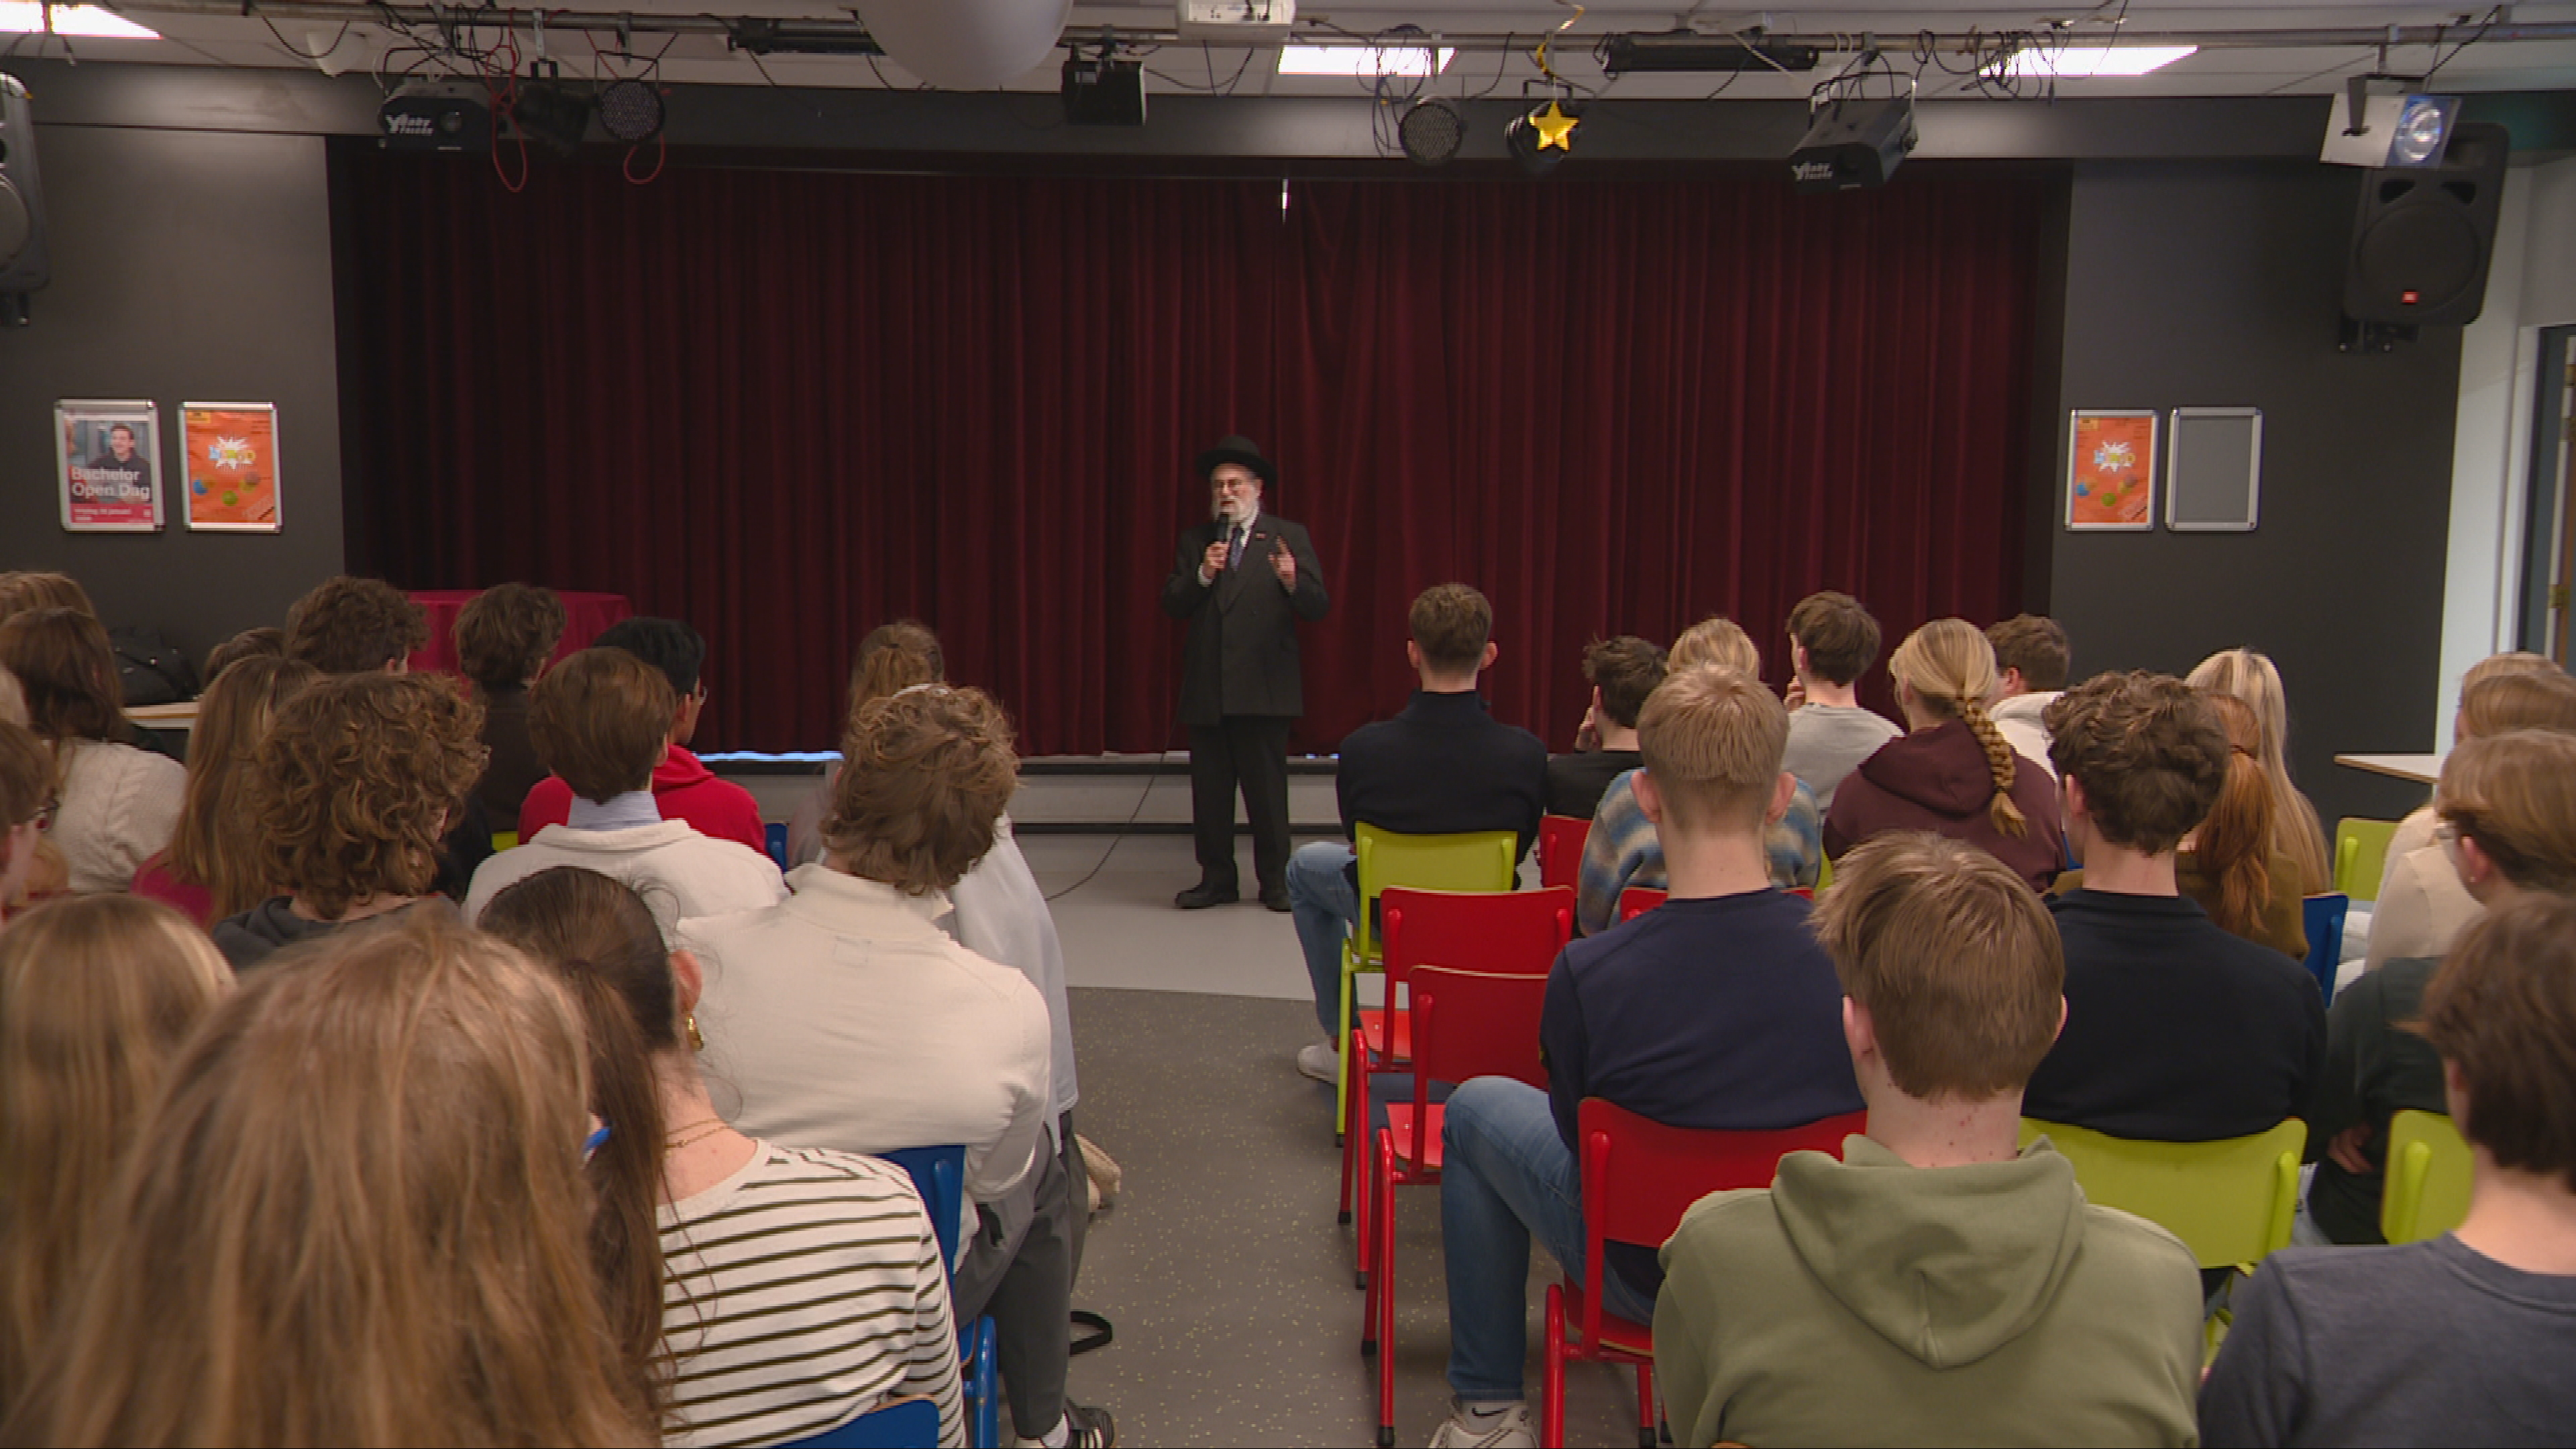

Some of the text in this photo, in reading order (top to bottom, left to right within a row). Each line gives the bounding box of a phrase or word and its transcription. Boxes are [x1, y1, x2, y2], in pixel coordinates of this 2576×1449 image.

[71, 467, 141, 481] Bachelor
[72, 483, 150, 500] Open Dag
